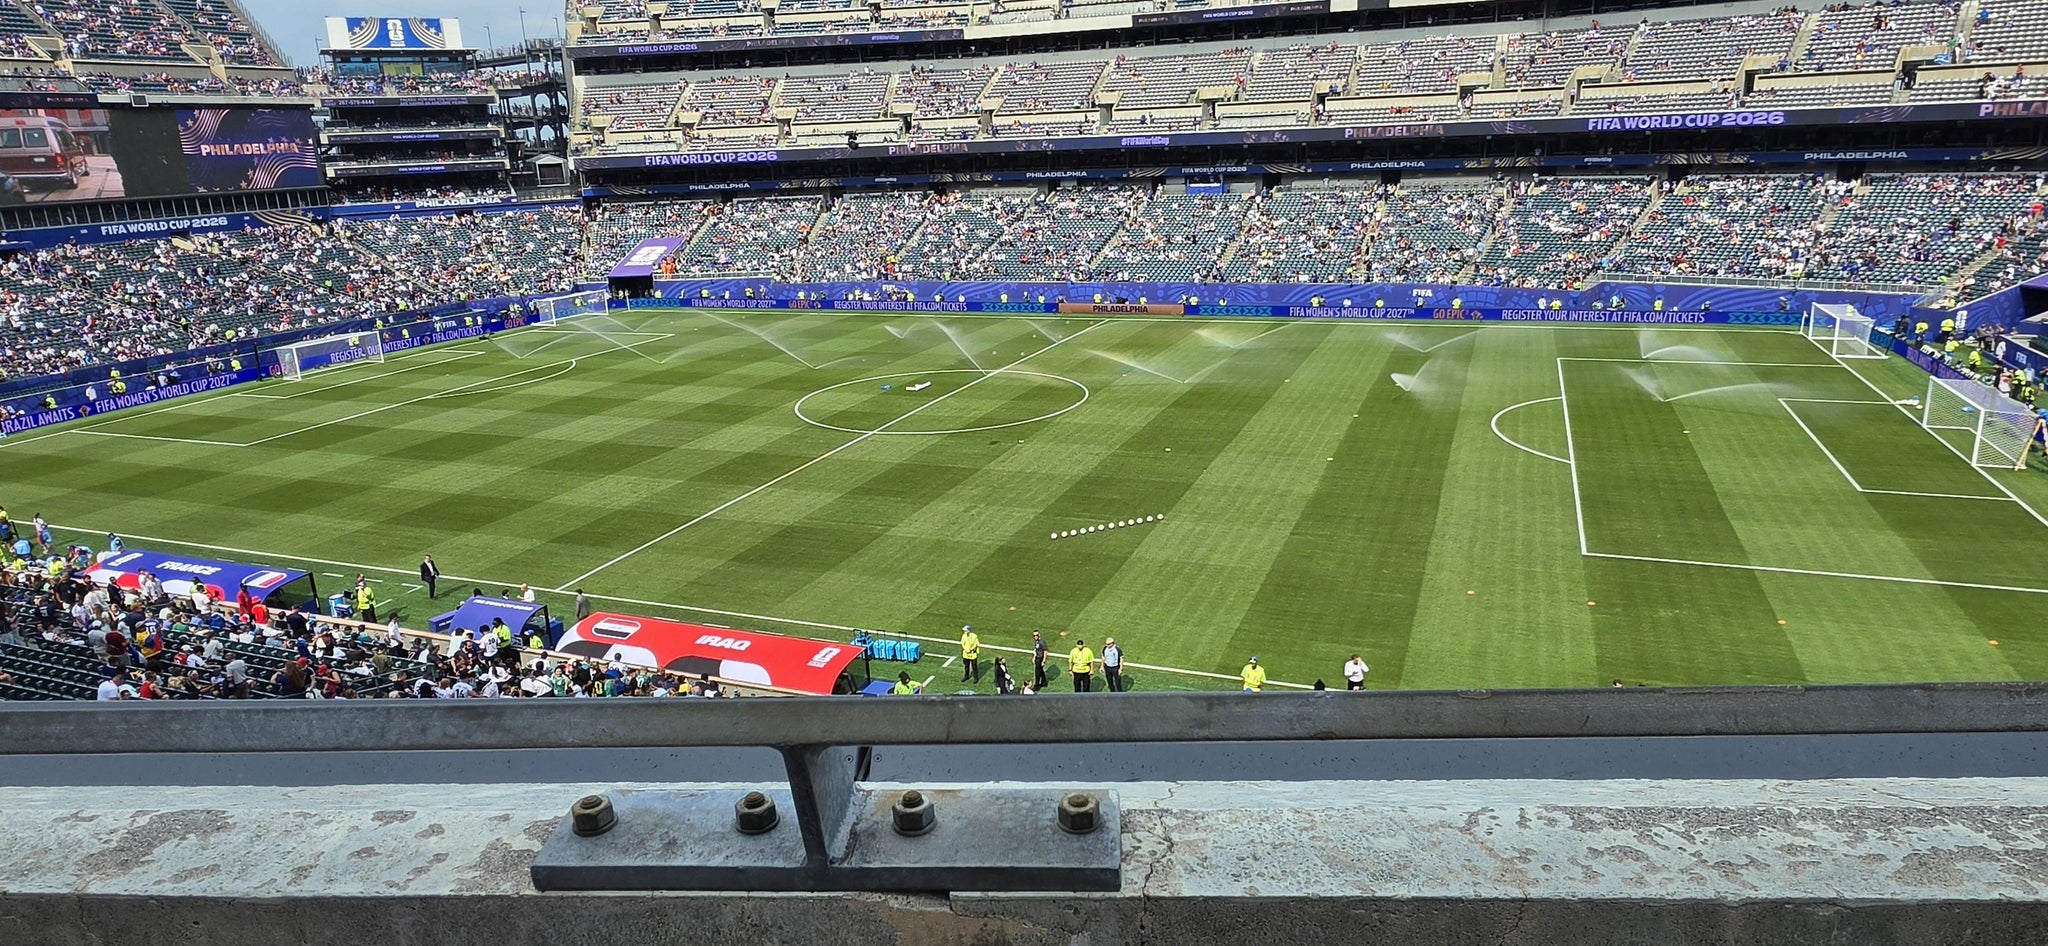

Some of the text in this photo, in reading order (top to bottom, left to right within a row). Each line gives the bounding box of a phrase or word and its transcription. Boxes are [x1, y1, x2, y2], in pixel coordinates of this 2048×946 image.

[1588, 112, 1784, 130] FIFA WORLD CUP 2026
[1345, 125, 1444, 138] PHILADELPHIA
[1121, 137, 1169, 146] #FIFAWorldCup
[200, 142, 299, 156] PHILADELPHIA
[645, 151, 778, 166] FIFA WORLD CUP 2026
[1804, 151, 1907, 160] PHILADELPHIA
[1350, 161, 1425, 169] PHILADELPHIA
[416, 196, 501, 208] PHILADELPHIA
[101, 217, 228, 235] FIFA WORLD CUP 2026
[1413, 289, 1432, 297] FIFA
[703, 299, 726, 307] WOMEN'S
[746, 300, 757, 308] CUP
[788, 300, 797, 308] GO
[834, 301, 967, 311] REGISTER YOUR INTEREST AT FIFA.COM/TICKETS
[1093, 305, 1148, 313] PHILADELPHIA
[1290, 307, 1306, 316] FIFA
[1306, 308, 1340, 317] WOMEN'S
[1341, 308, 1368, 317] WORLD
[1370, 309, 1385, 318] CUP
[1433, 309, 1446, 319] GO
[1502, 310, 1705, 324] REGISTER YOUR INTEREST AT FIFA.COM/TICKETS
[504, 319, 512, 329] GO
[330, 348, 365, 363] REGISTER
[383, 340, 412, 353] INTEREST
[413, 337, 421, 346] AT
[433, 326, 484, 343] FIFA.COM/TICKETS
[269, 364, 280, 375] GO
[38, 407, 75, 426] AWAITS
[96, 401, 116, 413] FIFA
[116, 389, 158, 409] WOMEN'S
[159, 383, 190, 398] WORLD
[190, 379, 208, 393] CUP
[156, 561, 222, 576] FRANCE
[694, 635, 751, 651] IRAQ
